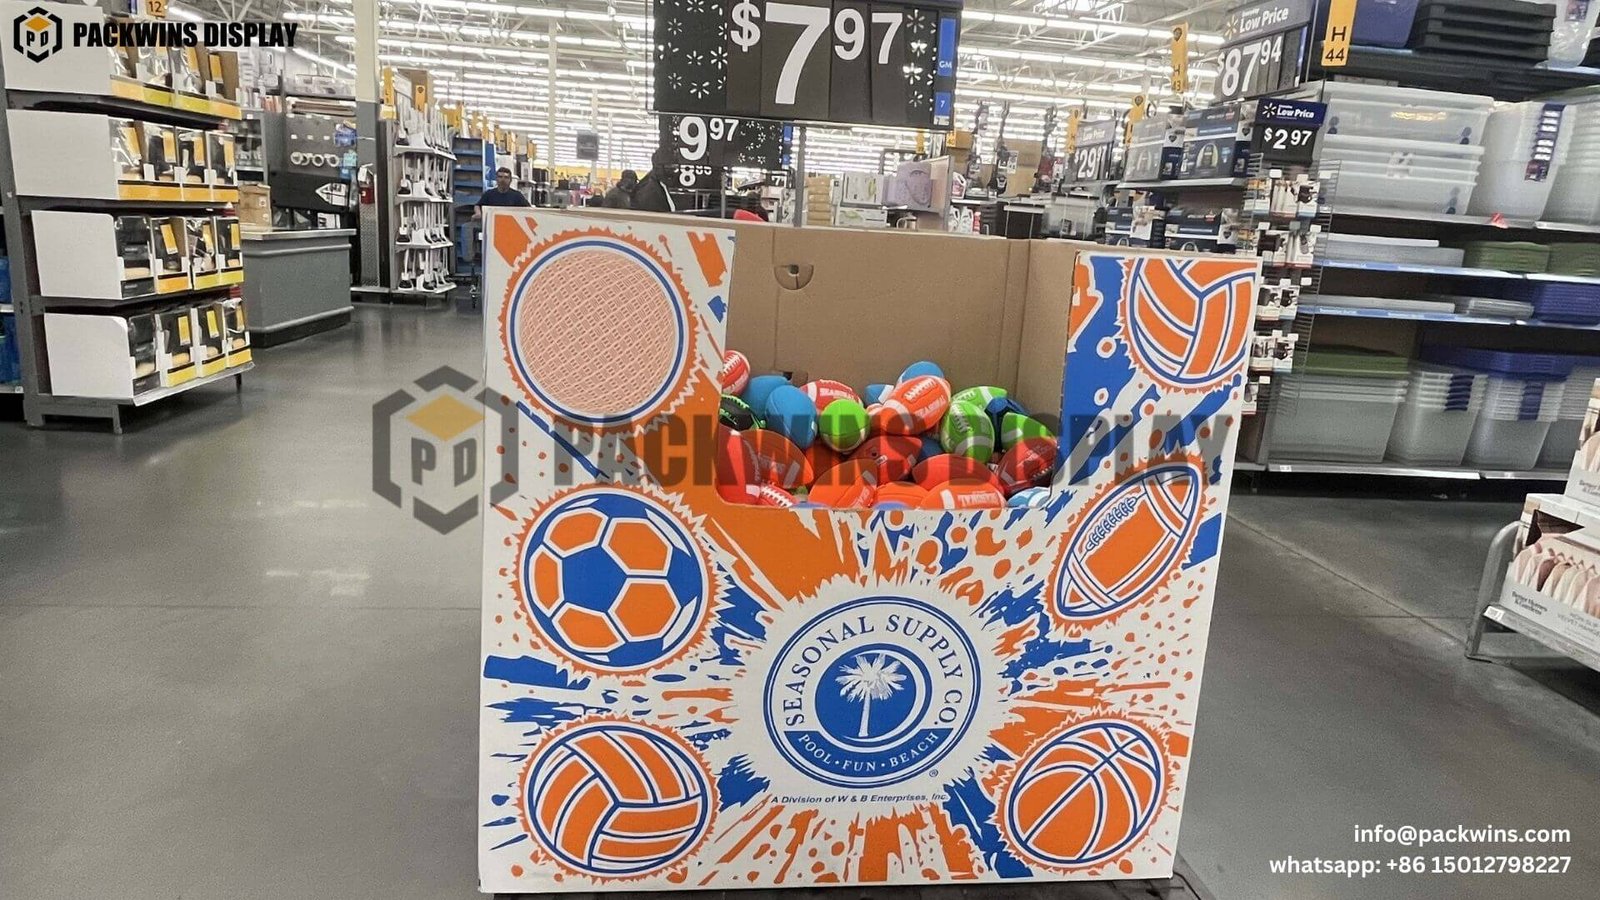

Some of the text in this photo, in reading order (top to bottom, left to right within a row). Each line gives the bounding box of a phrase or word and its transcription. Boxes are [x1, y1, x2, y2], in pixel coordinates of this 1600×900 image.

[149, 1, 162, 13] 12
[1240, 16, 1261, 33] Low
[1262, 7, 1289, 27] Price
[1331, 26, 1347, 42] H
[1325, 47, 1345, 62] 44
[939, 60, 952, 69] GM
[1277, 104, 1295, 117] Low
[1294, 108, 1315, 119] Price
[783, 613, 964, 727] SEASONAL SUPPLY CO.
[797, 732, 940, 773] POOL FUN BEACH
[771, 796, 779, 804] A
[781, 795, 822, 804] Division
[824, 795, 836, 804] of
[837, 795, 850, 803] W
[851, 795, 858, 803] &
[860, 795, 868, 803] B
